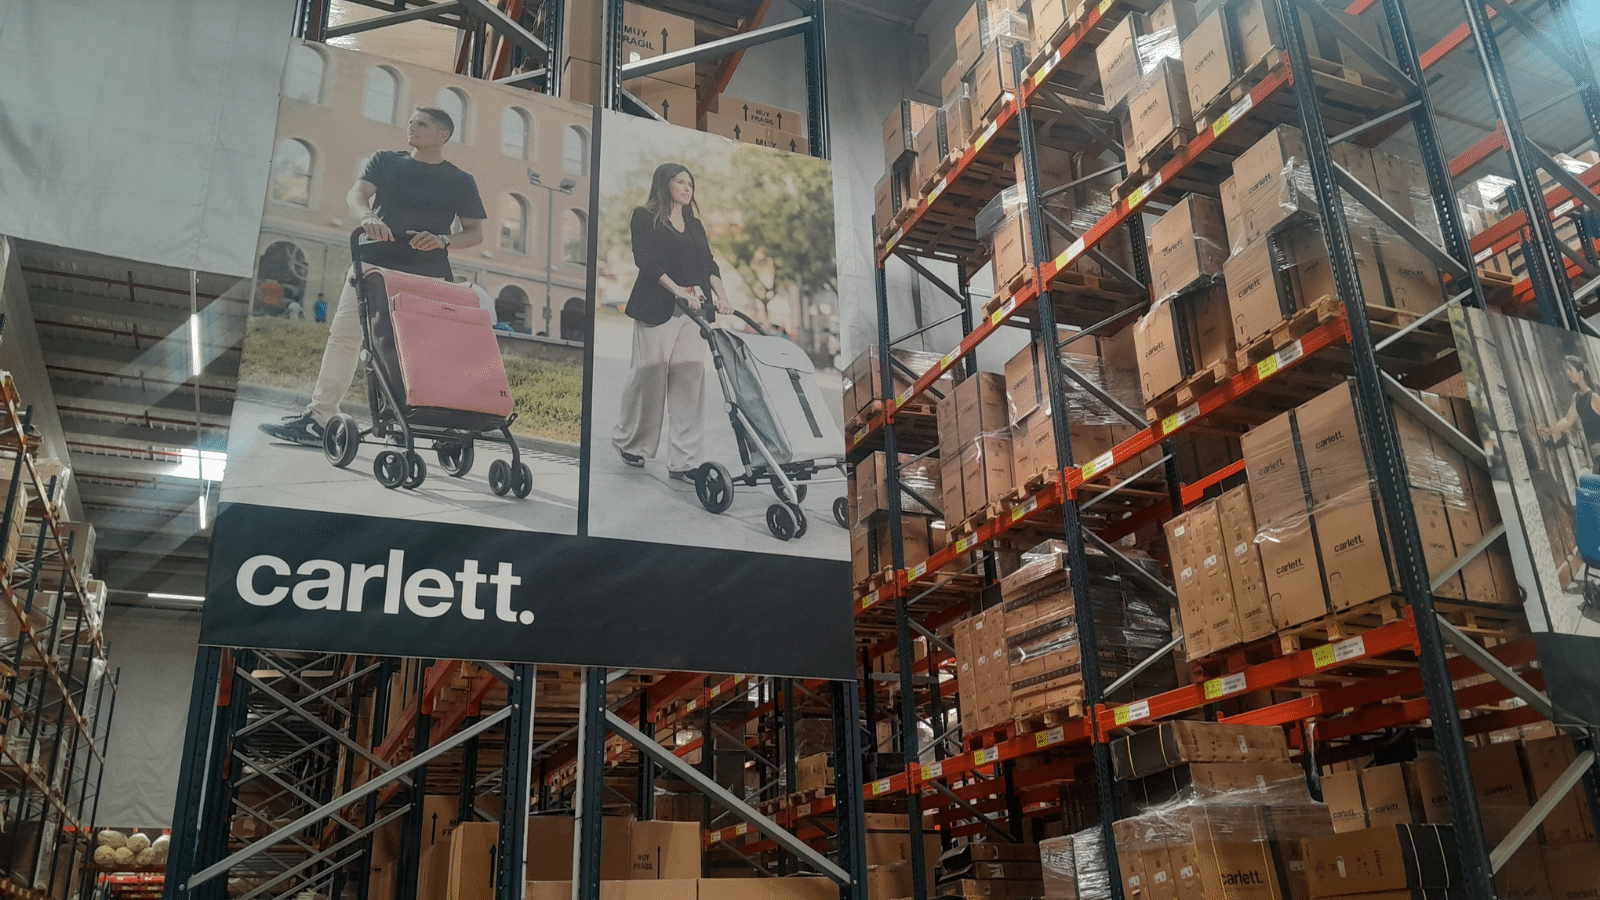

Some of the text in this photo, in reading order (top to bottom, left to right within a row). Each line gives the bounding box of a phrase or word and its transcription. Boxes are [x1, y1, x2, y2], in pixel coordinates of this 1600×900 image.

[624, 25, 648, 38] MUY
[622, 34, 656, 51] RAGIL
[751, 114, 775, 126] FRAGIL
[755, 109, 770, 117] MUY
[235, 548, 536, 626] carlett.
[1221, 870, 1264, 885] carlett.
